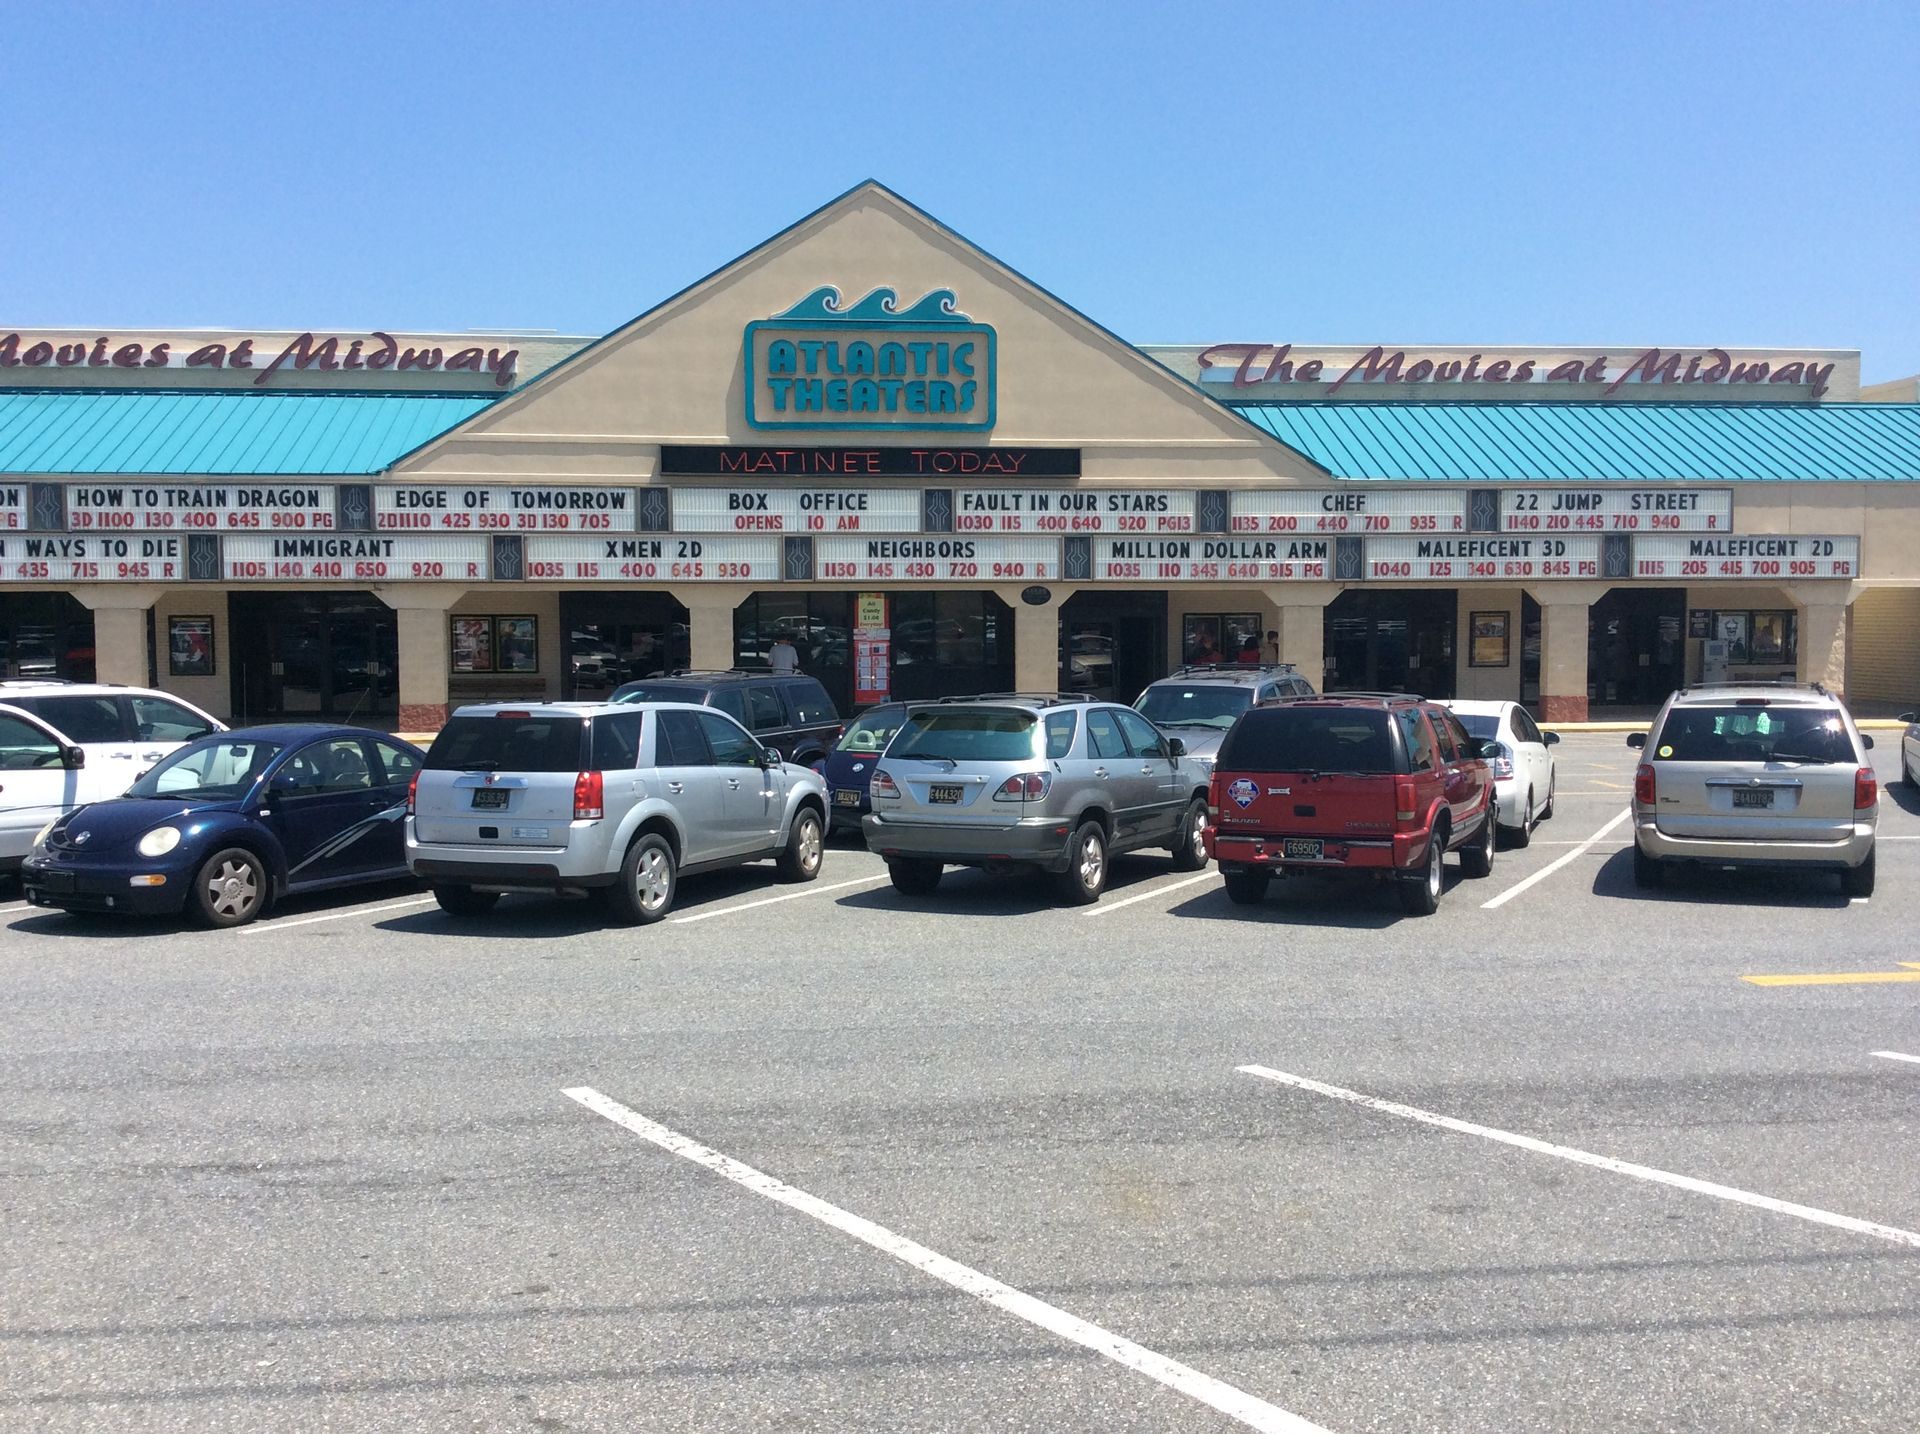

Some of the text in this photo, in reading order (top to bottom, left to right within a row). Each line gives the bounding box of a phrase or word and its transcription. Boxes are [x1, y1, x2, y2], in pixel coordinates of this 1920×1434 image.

[186, 340, 253, 368] at
[254, 332, 519, 386] Midway
[769, 339, 974, 376] ATLANTIC
[1198, 344, 1835, 398] The Movies at Midway
[769, 378, 977, 413] THEATERS
[720, 451, 1027, 473] MATINEE TODAY
[77, 489, 319, 507] HOW TO TRAIN DRAGON
[396, 491, 626, 509] EDGE OF TOMORROW
[729, 493, 868, 510] BOX OFFICE
[964, 495, 1168, 512] FAULT IN OUR STARS
[1322, 495, 1366, 512] CHEF
[1516, 494, 1699, 511] 22 JUMP STREET
[71, 512, 333, 527] 3D 1100 130 400 645 900 PG
[442, 513, 471, 528] 425
[479, 513, 510, 528] 930
[517, 514, 537, 528] 3D
[543, 514, 569, 528] 130
[579, 514, 610, 528] 705
[735, 515, 860, 529] OPENS 10 AM
[957, 515, 1190, 530] 1030 115 400 640 920 PG13
[1232, 516, 1462, 530] 1135 200 440 710 935 R
[1508, 515, 1716, 529] 1140 210 445 710 940 R
[26, 540, 178, 557] WAYS TO DIE
[274, 540, 394, 557] IMMIGRANT
[678, 541, 702, 558] 2D
[868, 541, 975, 558] NEIGHBORS
[1112, 542, 1327, 558] MILLION DOLLAR ARM
[1418, 541, 1566, 557] MALEFICENT 3D
[1690, 540, 1834, 556] MALEFICENT 2D
[17, 562, 49, 577] 435
[72, 562, 98, 577] 715
[117, 562, 150, 577] 945
[164, 562, 173, 577] R
[232, 562, 477, 577] 1105 140 410 650 920 R
[528, 563, 751, 577] 1035 115 400 645 930
[824, 563, 1046, 577] 1130 145 430 720 940 R
[1107, 563, 1323, 577] 1035 110 345 640 915 PG
[1373, 561, 1596, 577] 1040 125 340 630 845 PG
[1639, 561, 1850, 575] 1115 205 415 700 905 PG
